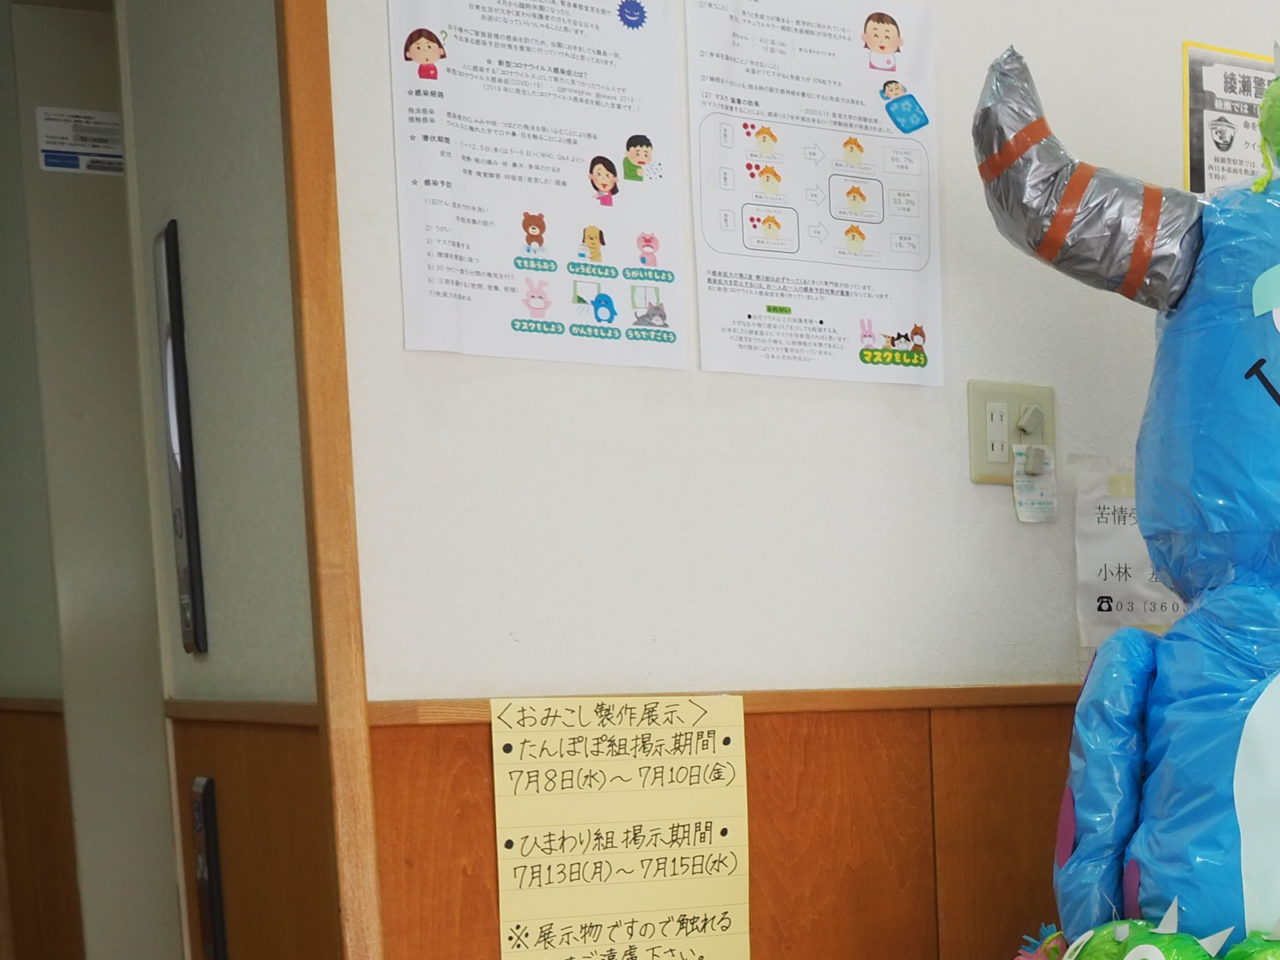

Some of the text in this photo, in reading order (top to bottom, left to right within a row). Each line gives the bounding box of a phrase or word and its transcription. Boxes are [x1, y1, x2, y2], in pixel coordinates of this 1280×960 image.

[515, 258, 673, 282] てをあらおう しょうどくしよう うがいをしよう
[513, 320, 675, 343] マスクをしよう かんきをしよう うちですごそう
[863, 350, 926, 366] マスクをしよう
[1097, 563, 1132, 582] 小林
